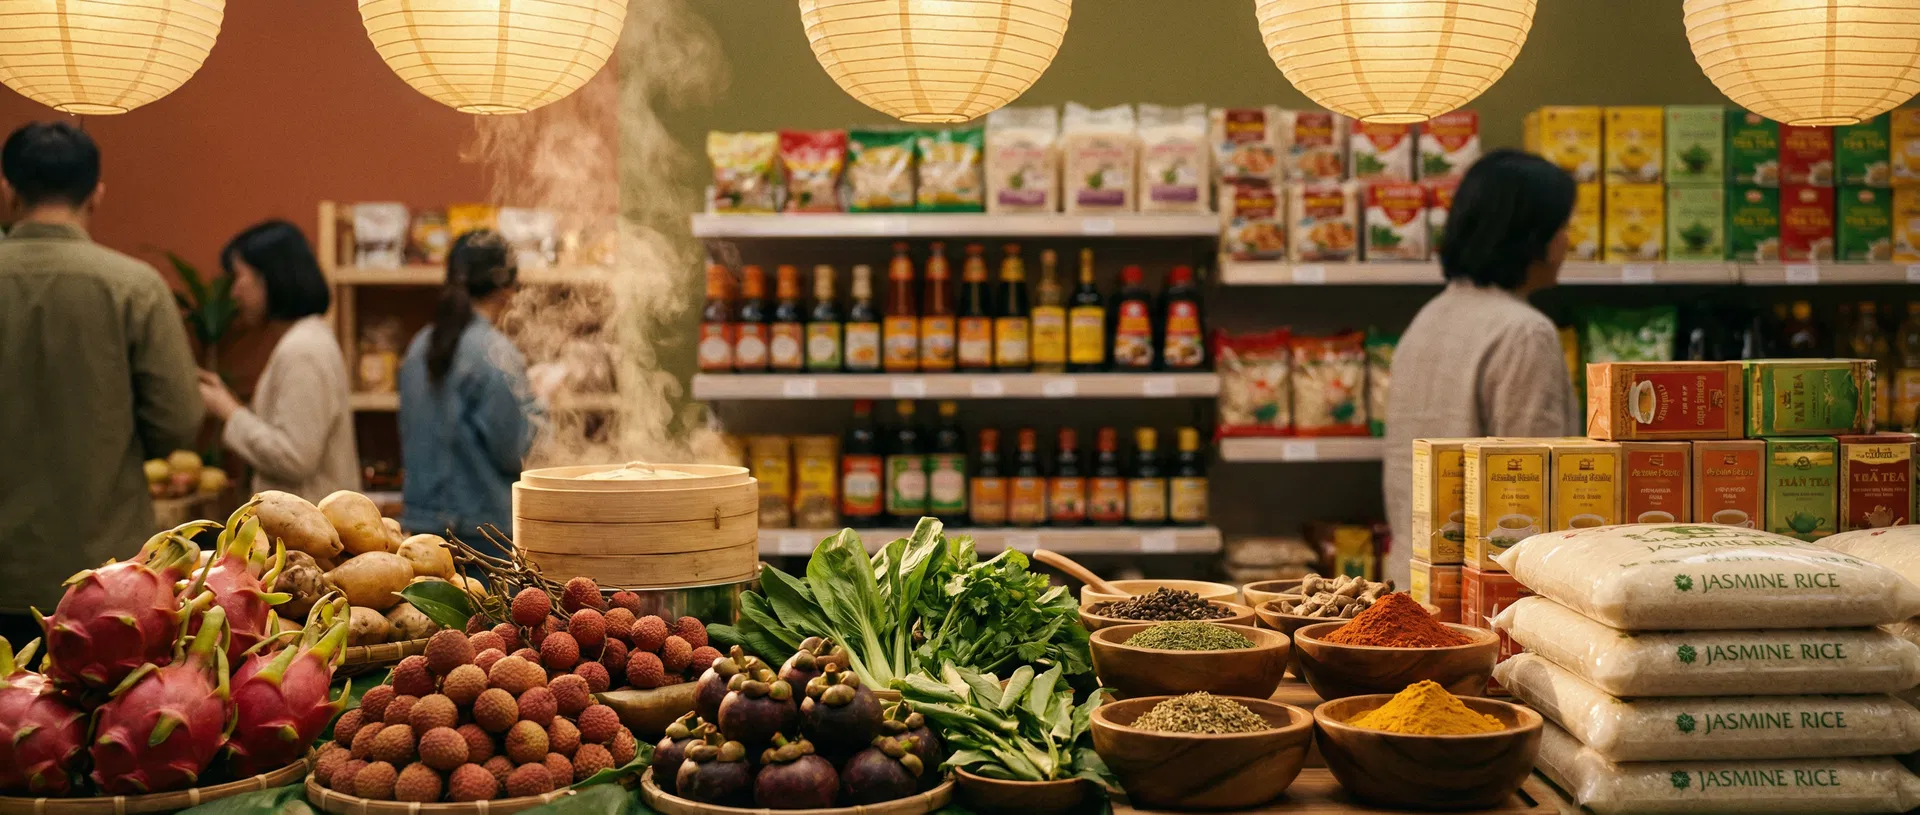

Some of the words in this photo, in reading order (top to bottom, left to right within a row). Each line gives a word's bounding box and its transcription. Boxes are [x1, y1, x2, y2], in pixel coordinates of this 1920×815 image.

[1701, 573, 1788, 593] JASMINE
[1794, 572, 1840, 589] RICE
[1705, 644, 1794, 665] JASMINE
[1800, 643, 1847, 660] RICE
[1704, 712, 1794, 735] JASMINE
[1800, 711, 1847, 729] RICE
[1699, 769, 1788, 792] JASMINE
[1794, 768, 1841, 787] RICE
